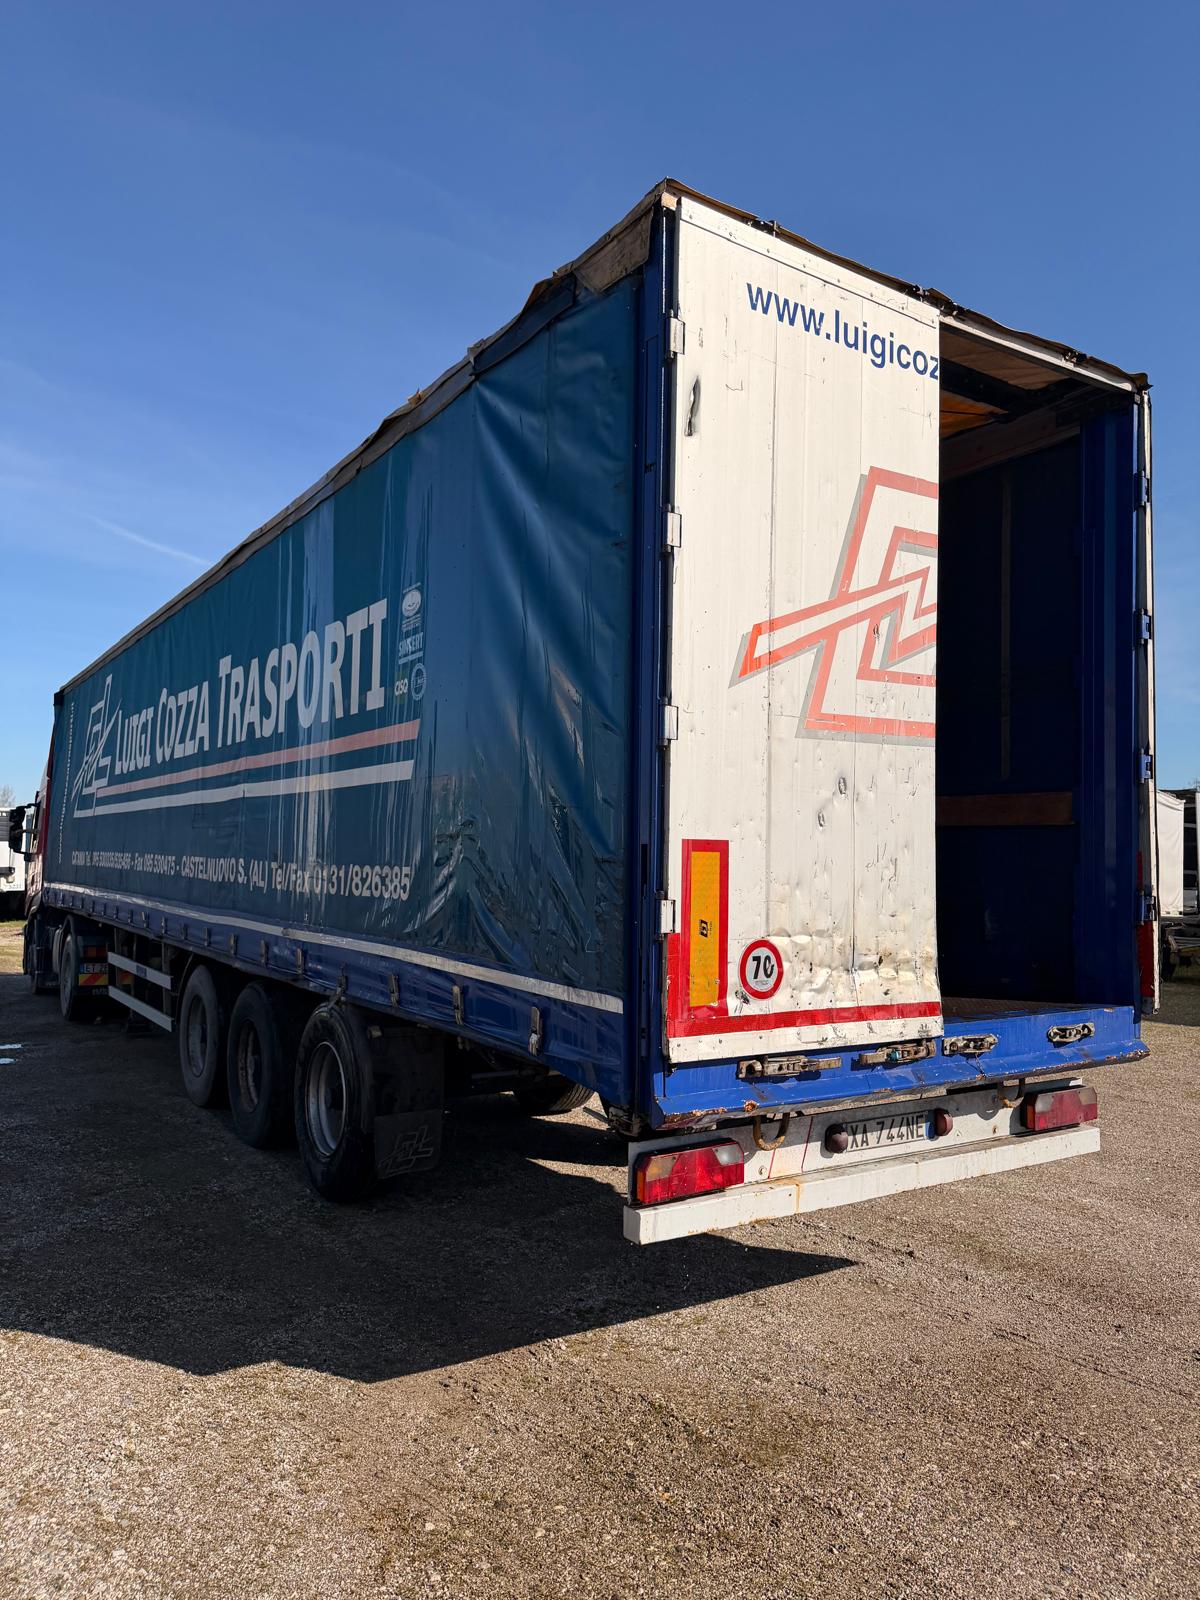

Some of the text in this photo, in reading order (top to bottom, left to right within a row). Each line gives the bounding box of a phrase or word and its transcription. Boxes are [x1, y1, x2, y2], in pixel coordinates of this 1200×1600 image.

[114, 706, 154, 775] LUIGI
[155, 681, 210, 765] COZZA
[217, 599, 388, 748] TRASPORTI
[134, 852, 143, 871] Fax
[181, 855, 236, 882] CASTELNUOVO
[238, 858, 247, 884] S.
[249, 859, 269, 894] (AL)
[752, 955, 775, 979] 70
[850, 1123, 869, 1149] XA
